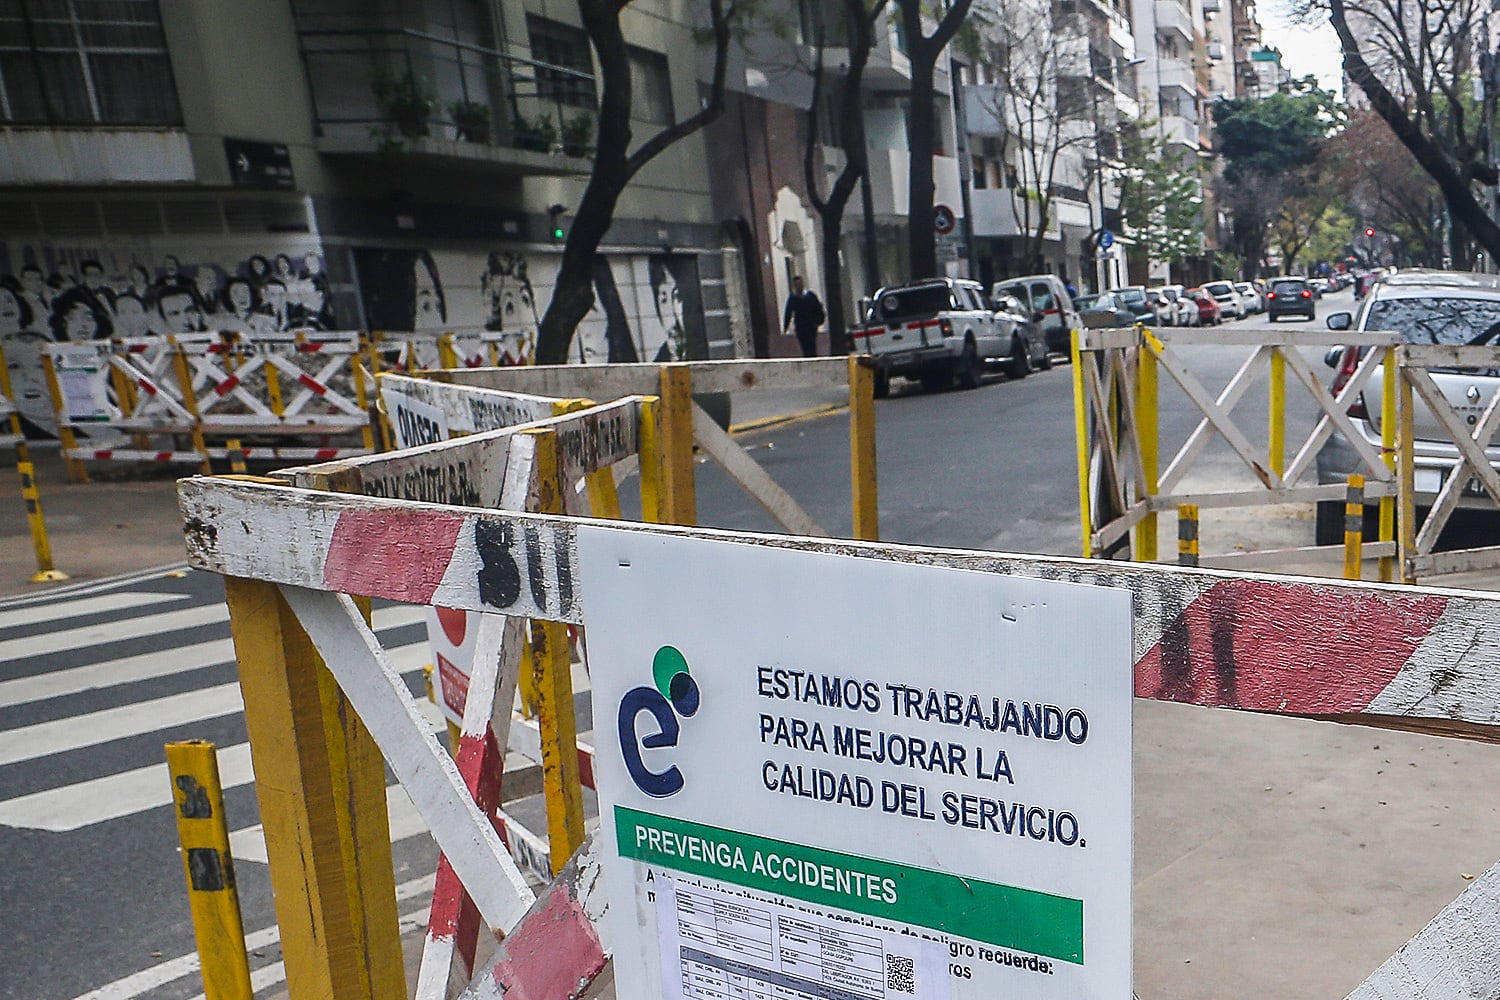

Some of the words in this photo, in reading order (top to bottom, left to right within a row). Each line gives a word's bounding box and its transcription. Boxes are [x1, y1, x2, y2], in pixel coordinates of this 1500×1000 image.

[758, 667, 881, 713] ESTAMOS
[886, 683, 1089, 746] TRABAJANDO
[760, 713, 827, 756] PARA
[831, 725, 967, 776] MEJORAR
[976, 748, 1014, 784] LA
[762, 760, 874, 810] CALIDAD
[882, 788, 935, 820] DEL
[941, 790, 1087, 848] SERVICIO.
[635, 825, 747, 873] PREVENGA
[752, 849, 898, 904] ACCIDENTES
[978, 946, 1054, 975] recuerde:
